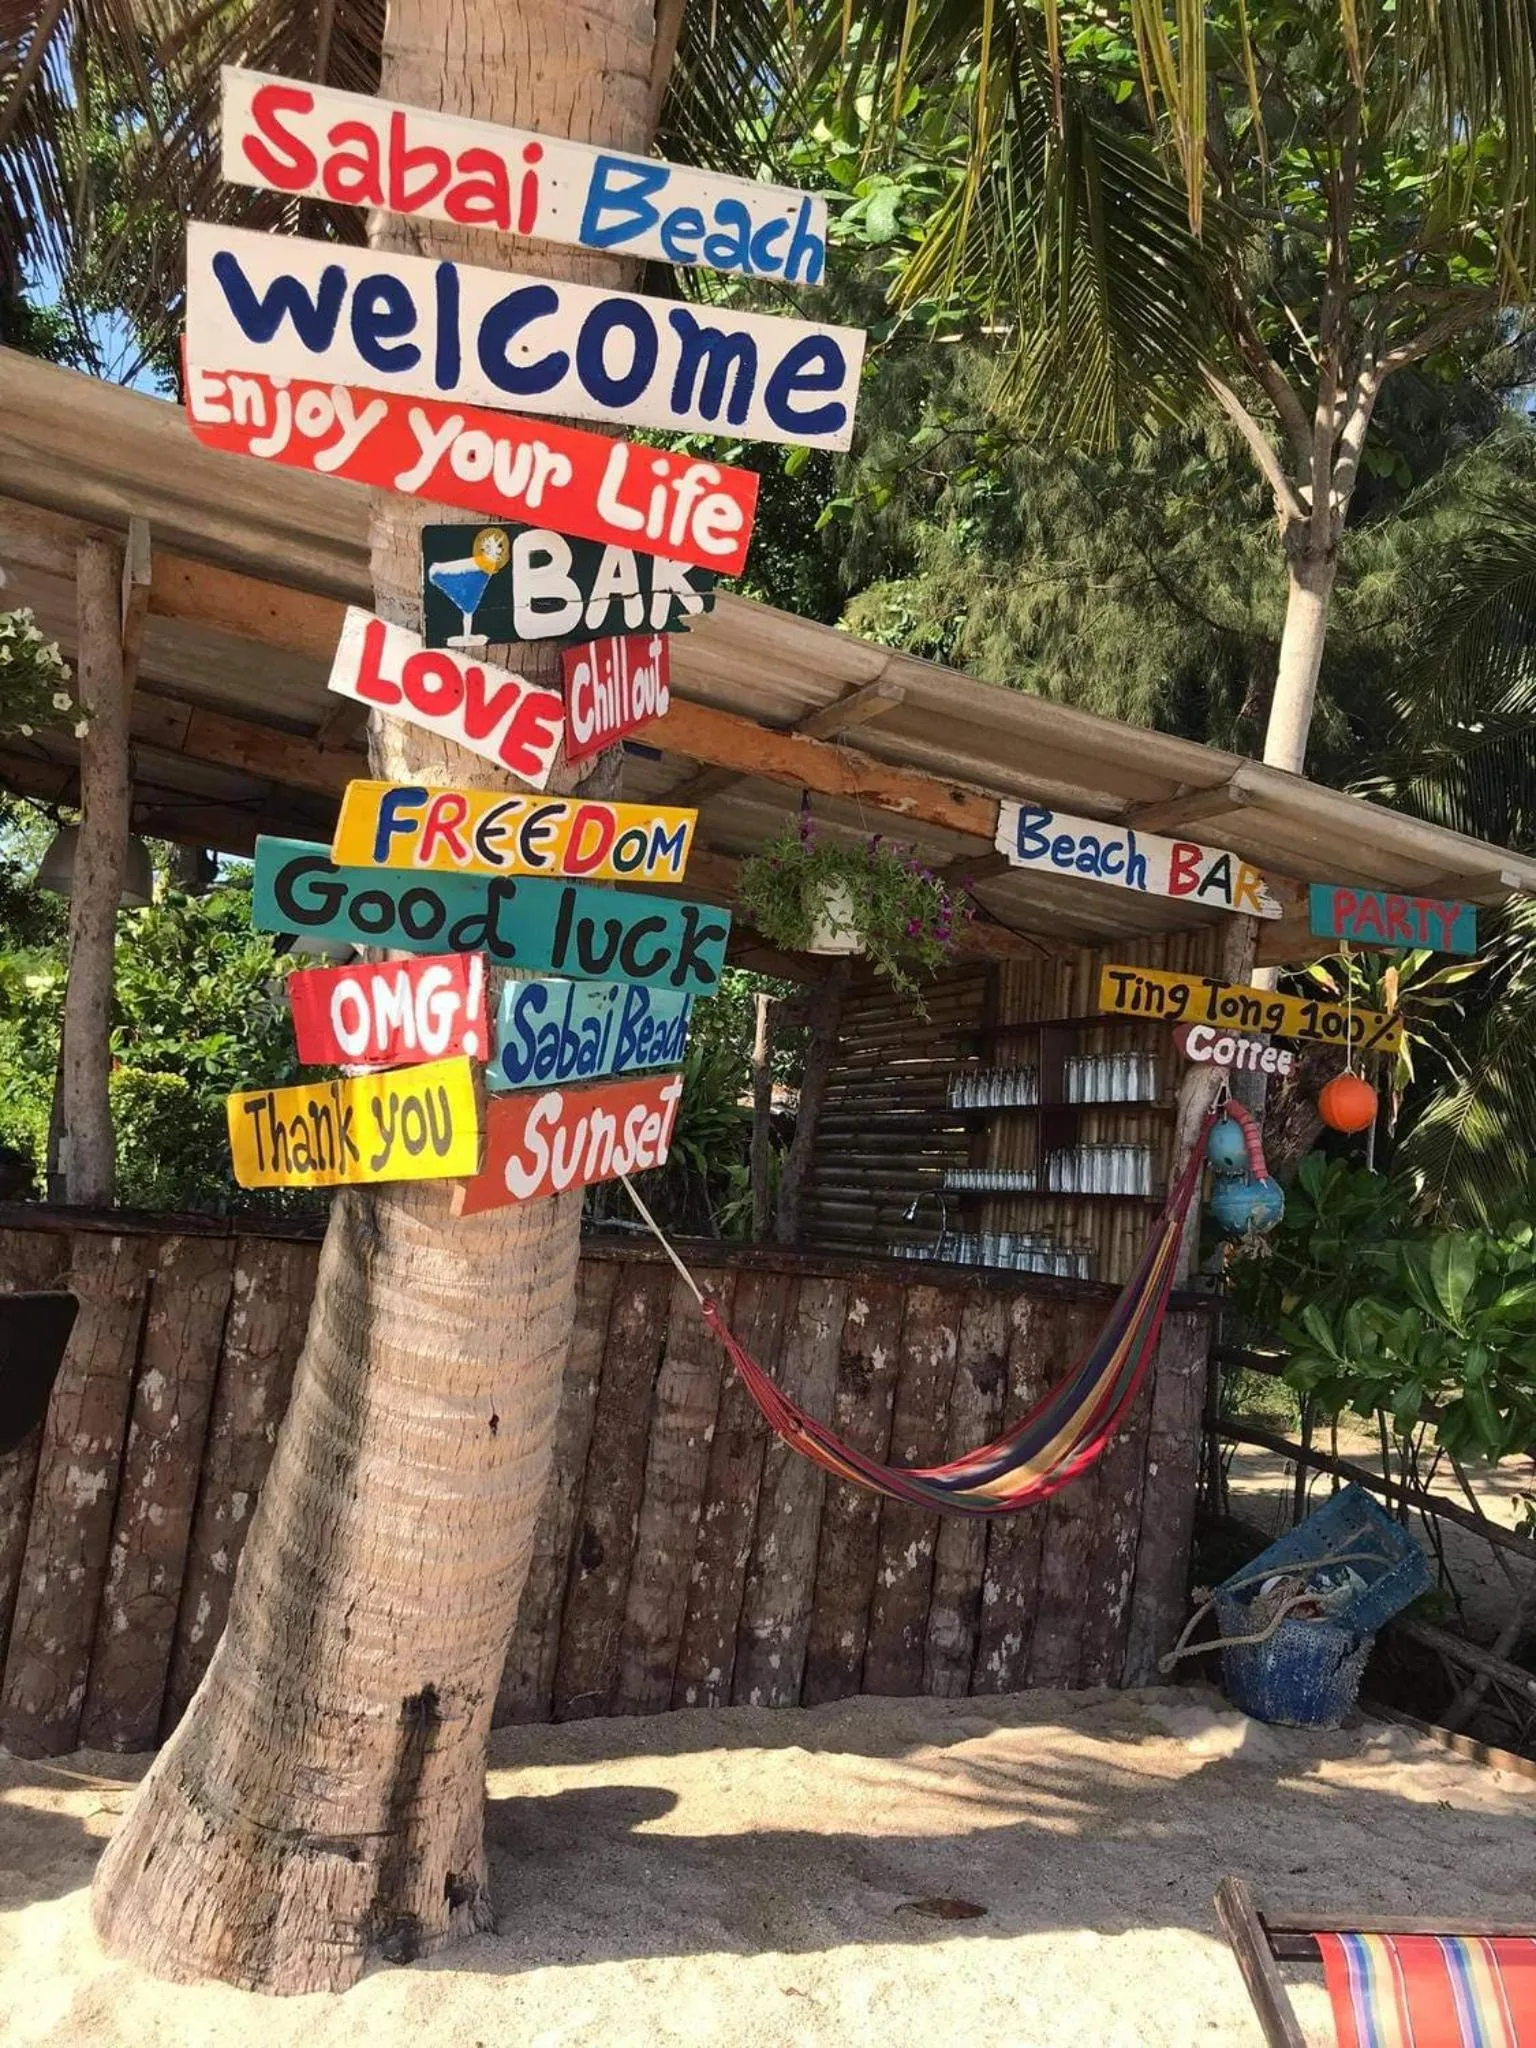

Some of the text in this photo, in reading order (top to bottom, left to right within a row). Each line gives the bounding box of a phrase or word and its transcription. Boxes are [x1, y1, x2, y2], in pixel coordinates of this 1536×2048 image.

[242, 85, 823, 284] Sabai Beach
[186, 368, 387, 473] Enjoy
[597, 443, 743, 556] Life
[511, 529, 705, 640] BAR
[355, 618, 567, 777] LOVE
[631, 633, 670, 718] out
[1015, 806, 1264, 914] Beach BAR
[273, 855, 727, 987] Good luck
[1331, 888, 1461, 950] PARTY
[330, 954, 479, 1056] OMG!
[502, 982, 690, 1084] Sabai Beach
[1108, 971, 1401, 1048] Ting Tong 100%
[244, 1086, 360, 1175] Thank
[505, 1076, 684, 1199] Sunset
